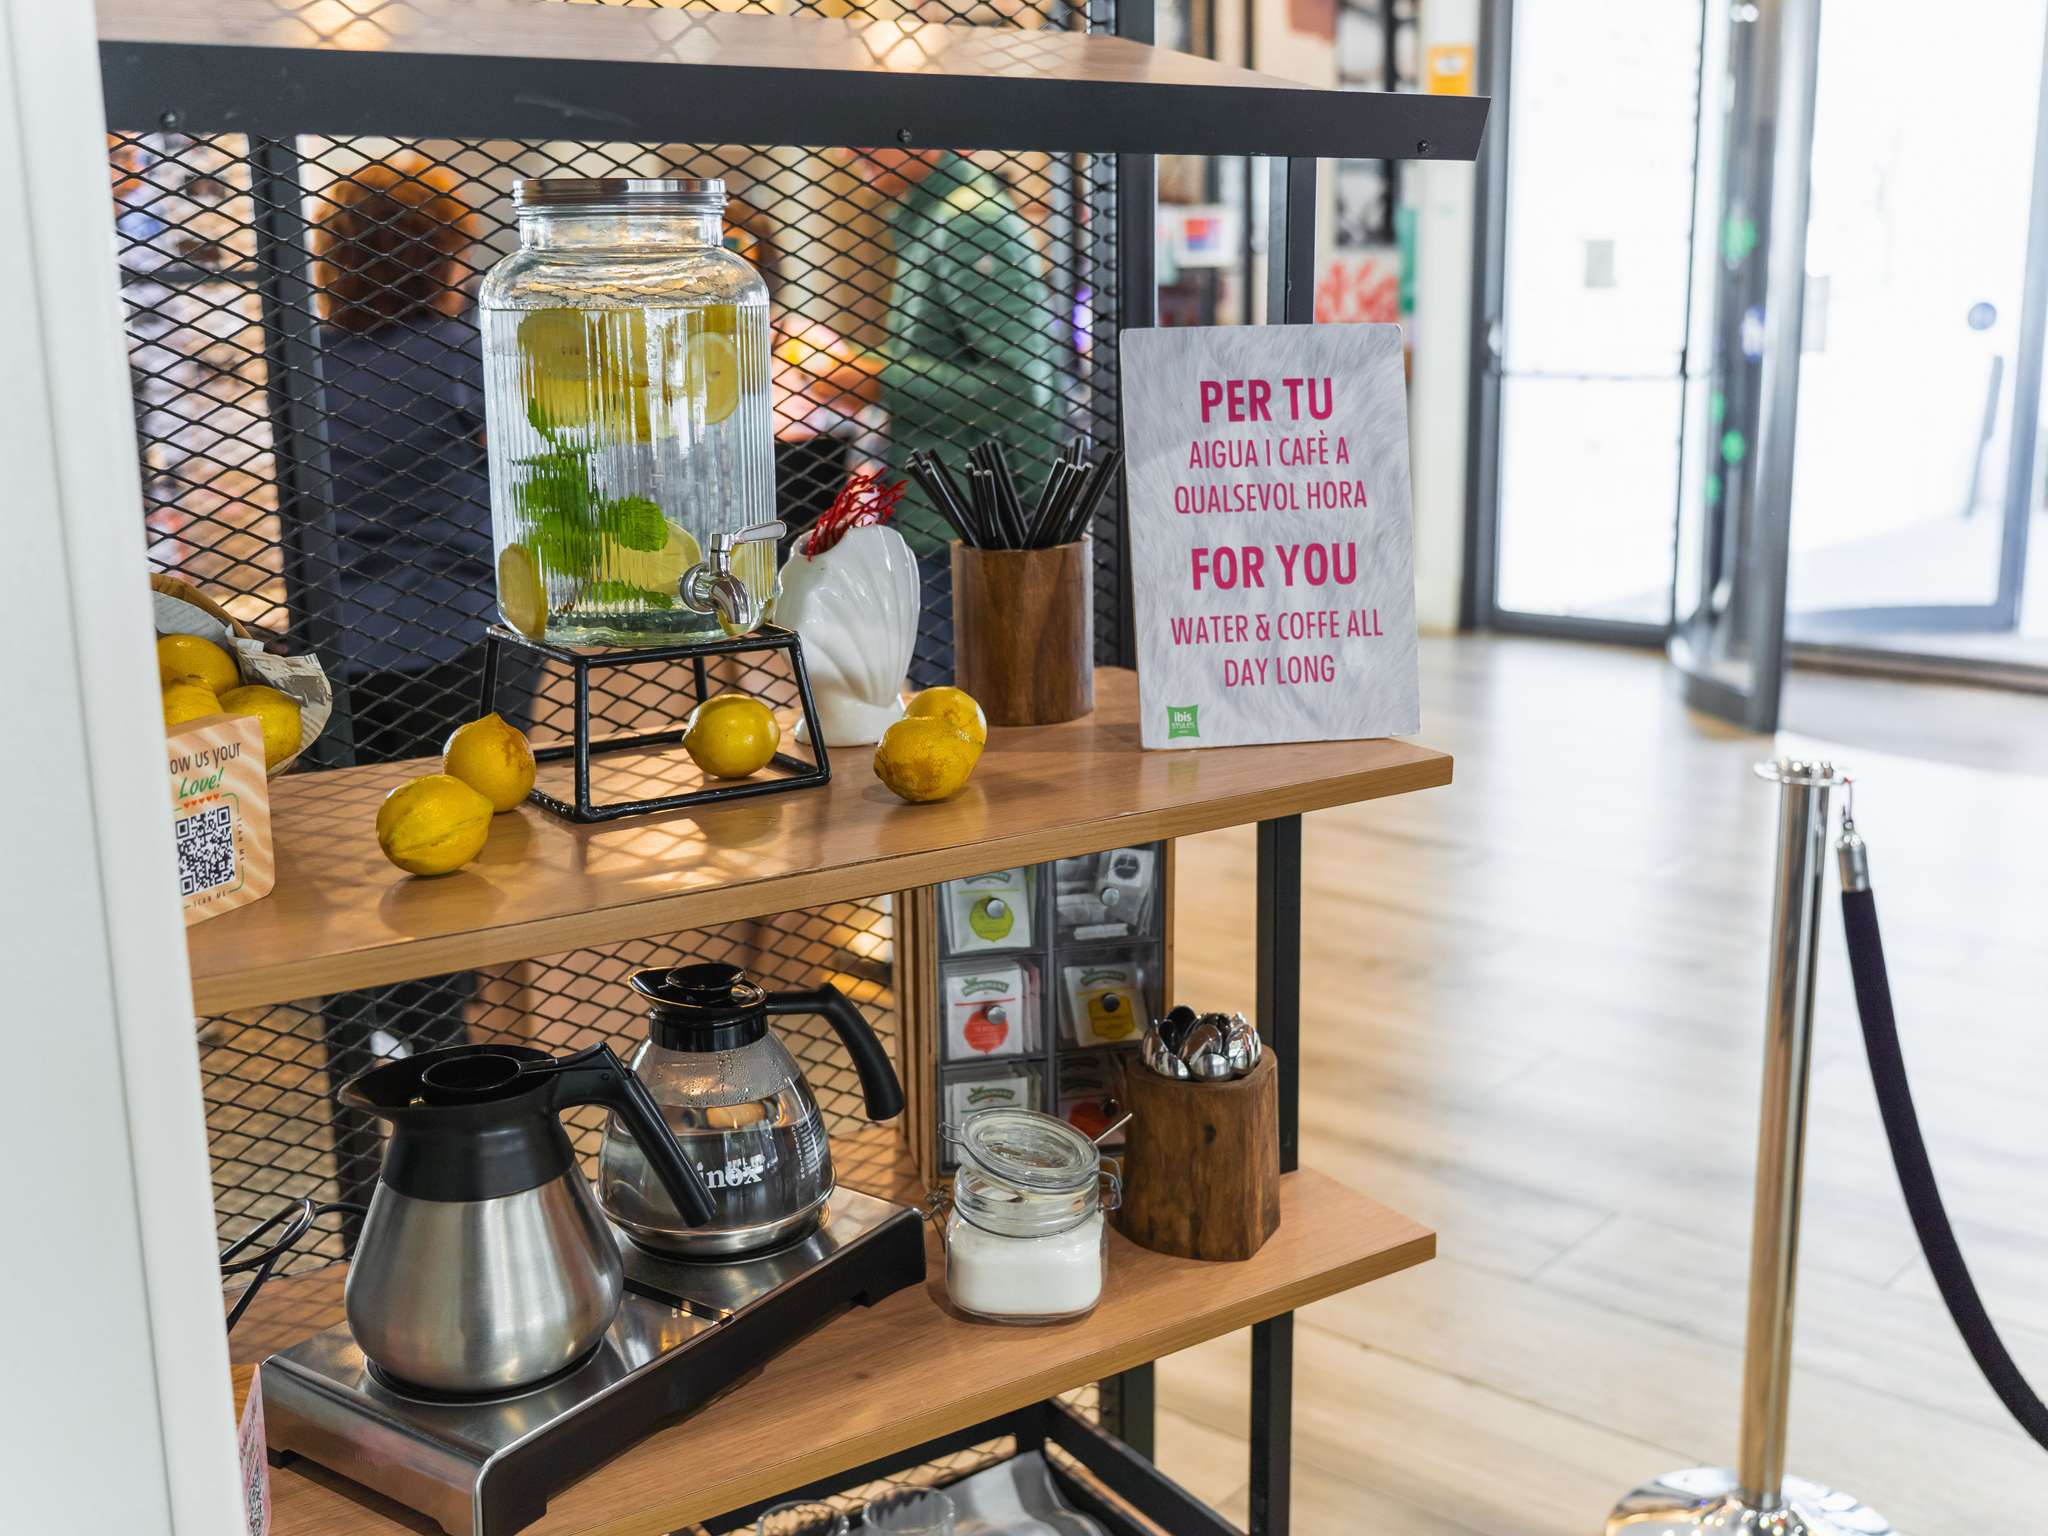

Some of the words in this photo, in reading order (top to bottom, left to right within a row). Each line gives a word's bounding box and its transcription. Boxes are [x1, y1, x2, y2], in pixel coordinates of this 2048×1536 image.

[1200, 379, 1272, 423] PER
[1282, 377, 1333, 421] TU
[1190, 440, 1257, 468] AIGUA
[1266, 439, 1271, 466] I
[1279, 430, 1329, 466] CAFÈ
[1336, 436, 1350, 464] A
[1171, 481, 1300, 514] QUALSEVOL
[1307, 480, 1366, 509] HORA
[1191, 546, 1264, 591] FOR
[1276, 543, 1356, 587] YOU
[1171, 615, 1249, 645] WATER
[1256, 614, 1270, 641] &
[1277, 608, 1339, 640] COFFE
[1347, 608, 1384, 637] ALL
[1224, 658, 1267, 688] DAY
[1277, 656, 1336, 684] LONG
[1174, 711, 1192, 722] ibis
[170, 755, 191, 775] ow
[195, 750, 209, 768] us
[179, 767, 225, 800] Love!
[791, 1126, 805, 1179] ATTENTION
